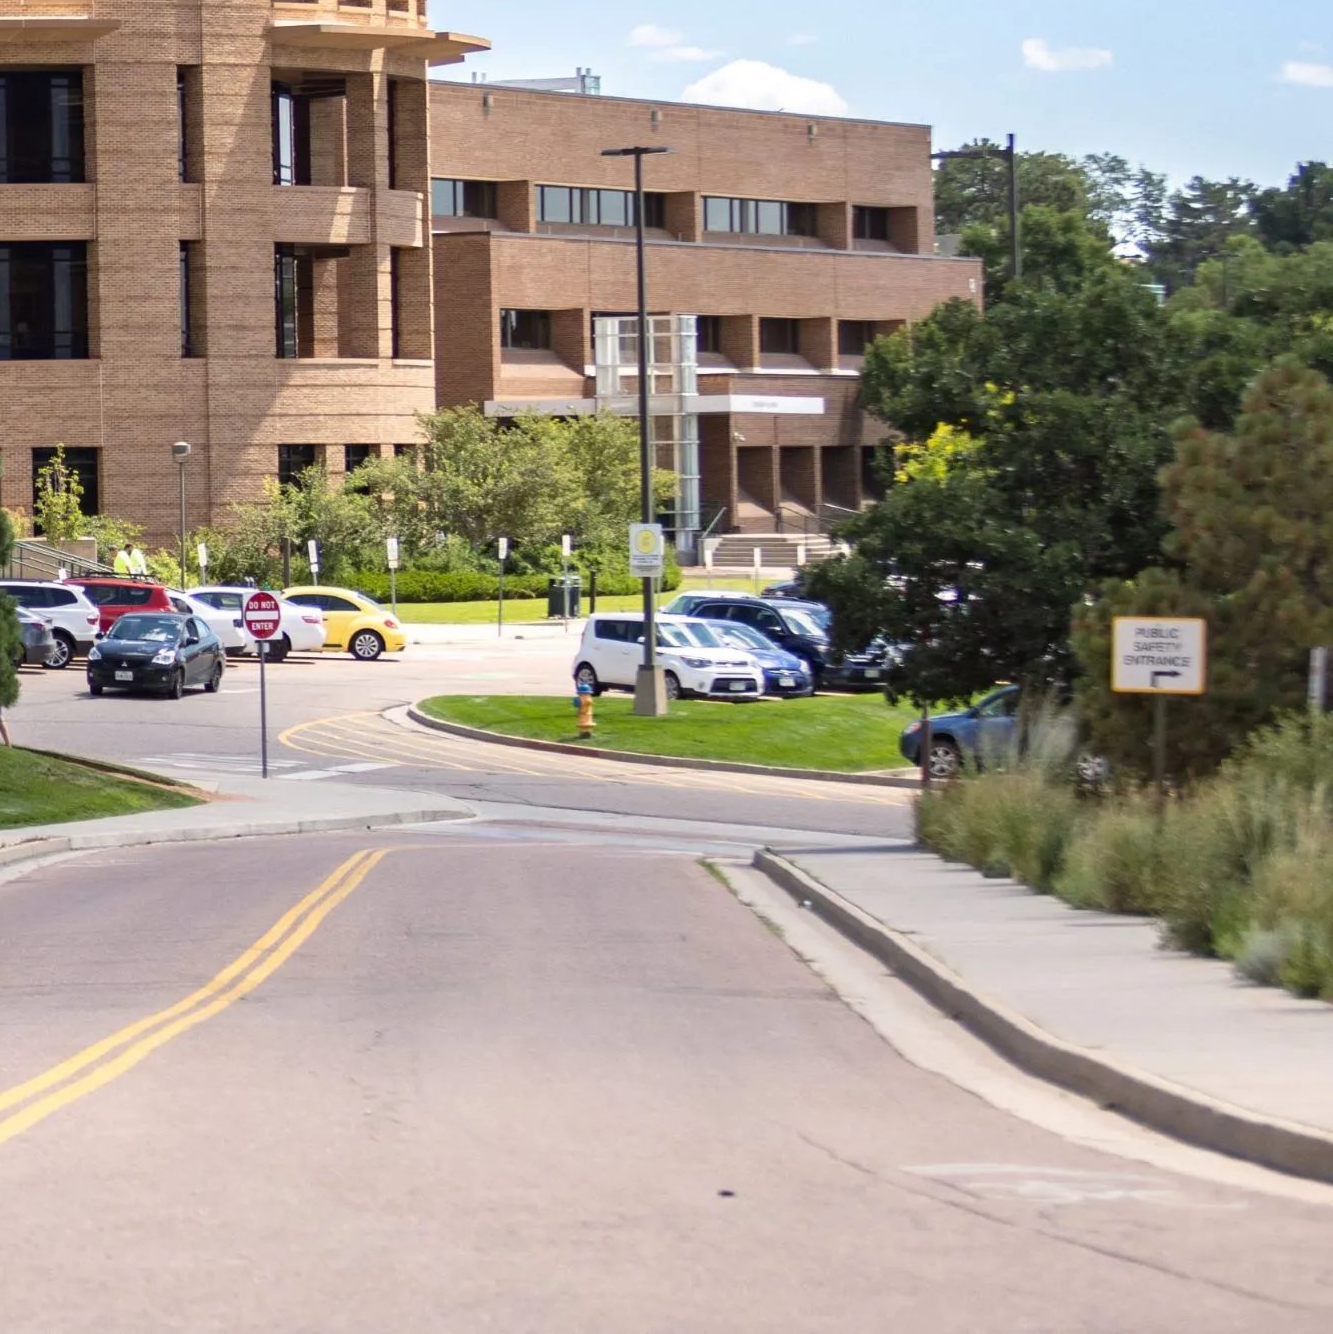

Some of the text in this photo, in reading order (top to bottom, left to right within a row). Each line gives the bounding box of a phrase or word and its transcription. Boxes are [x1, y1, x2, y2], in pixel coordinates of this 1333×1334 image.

[261, 601, 275, 609] NOT
[252, 622, 274, 630] ENTER
[1135, 628, 1179, 638] PUBLIC
[1133, 641, 1183, 652] SAFETY
[1123, 655, 1191, 666] ENTRANCE
